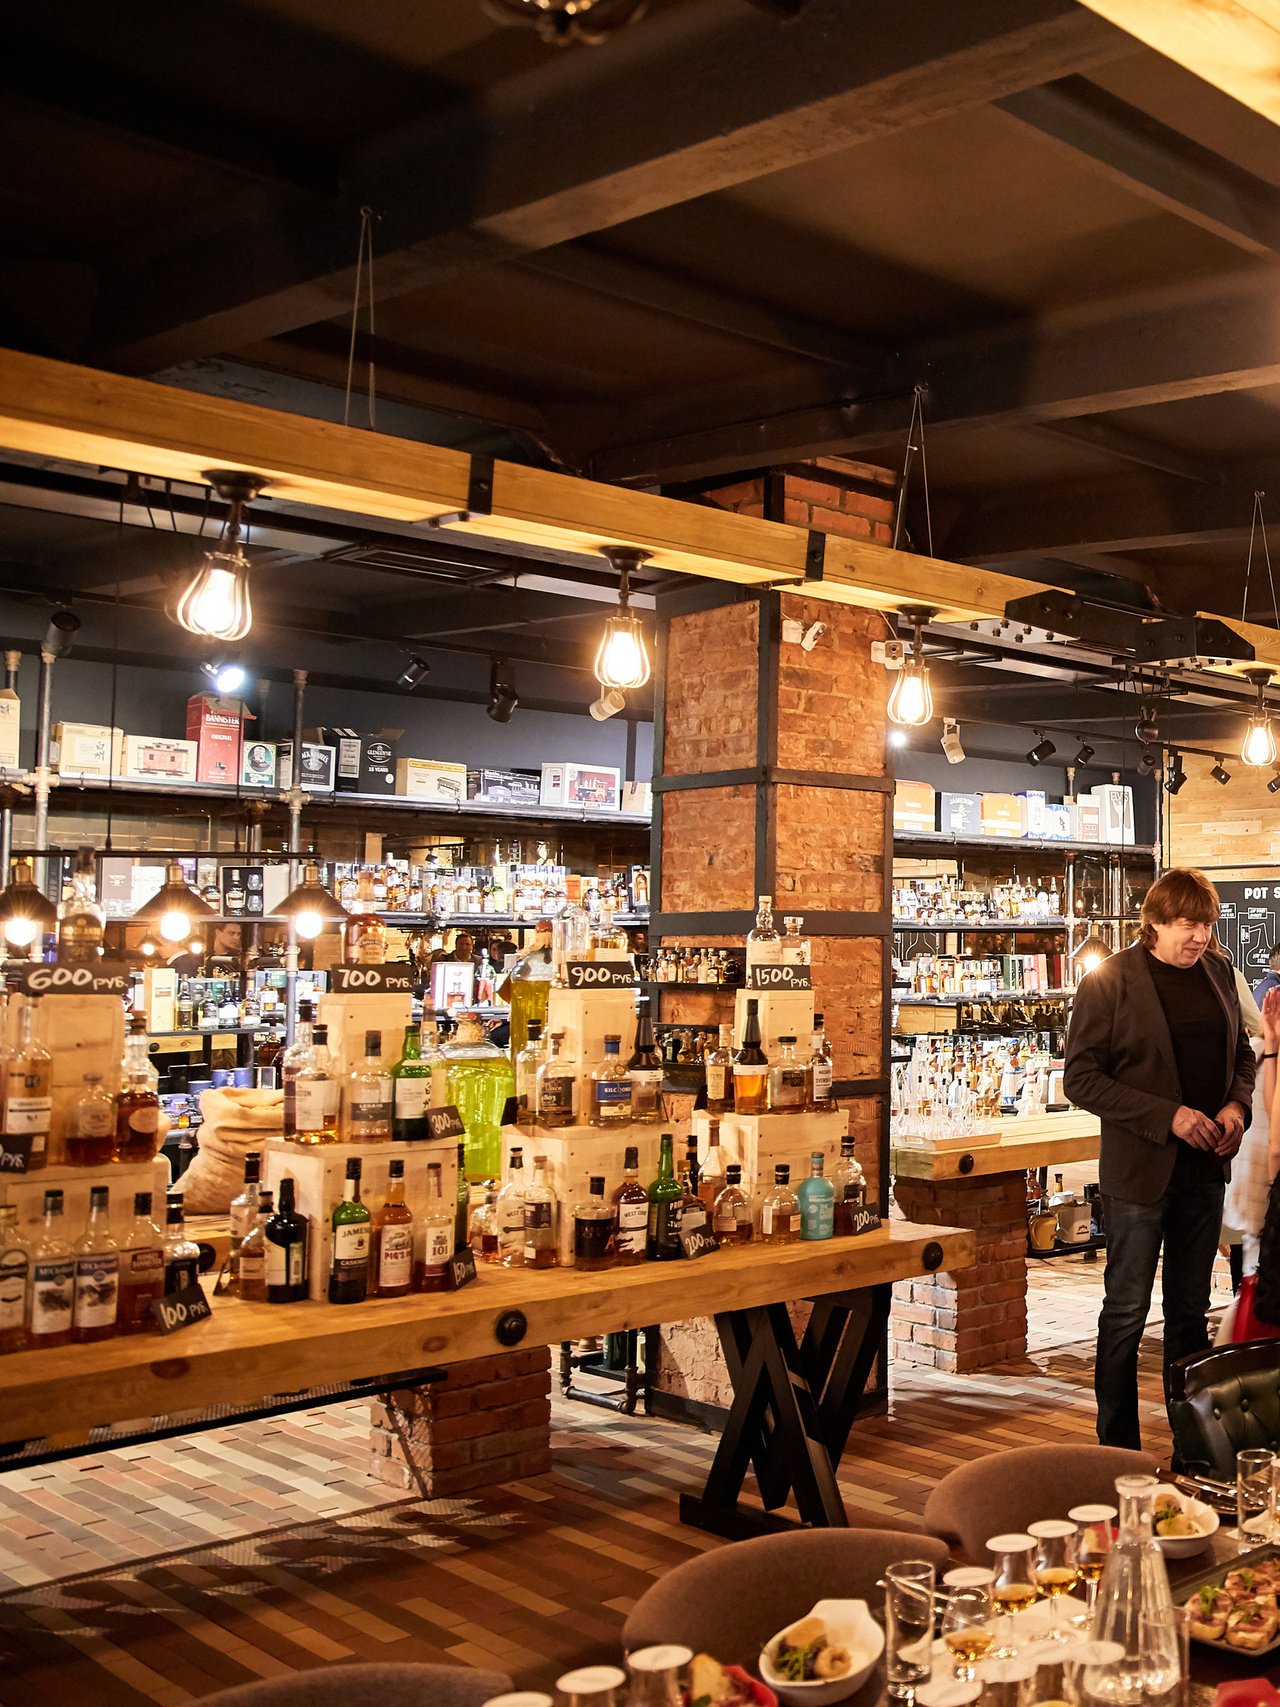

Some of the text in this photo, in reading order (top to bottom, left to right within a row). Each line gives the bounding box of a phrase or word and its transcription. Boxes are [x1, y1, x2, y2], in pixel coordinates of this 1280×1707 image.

[205, 713, 240, 724] BANNISTER
[948, 796, 975, 808] JAMESON
[1244, 887, 1269, 900] POT
[28, 967, 93, 991] 600
[339, 968, 381, 989] 700
[571, 966, 611, 987] 900
[755, 966, 794, 987] 1500
[431, 1112, 451, 1134] 300
[623, 1211, 637, 1219] WEST
[852, 1210, 870, 1232] 200
[341, 1226, 370, 1239] JAMES
[431, 1245, 449, 1256] 101
[685, 1233, 704, 1253] 200
[384, 1251, 405, 1260] PIG'S
[159, 1303, 187, 1329] 100
